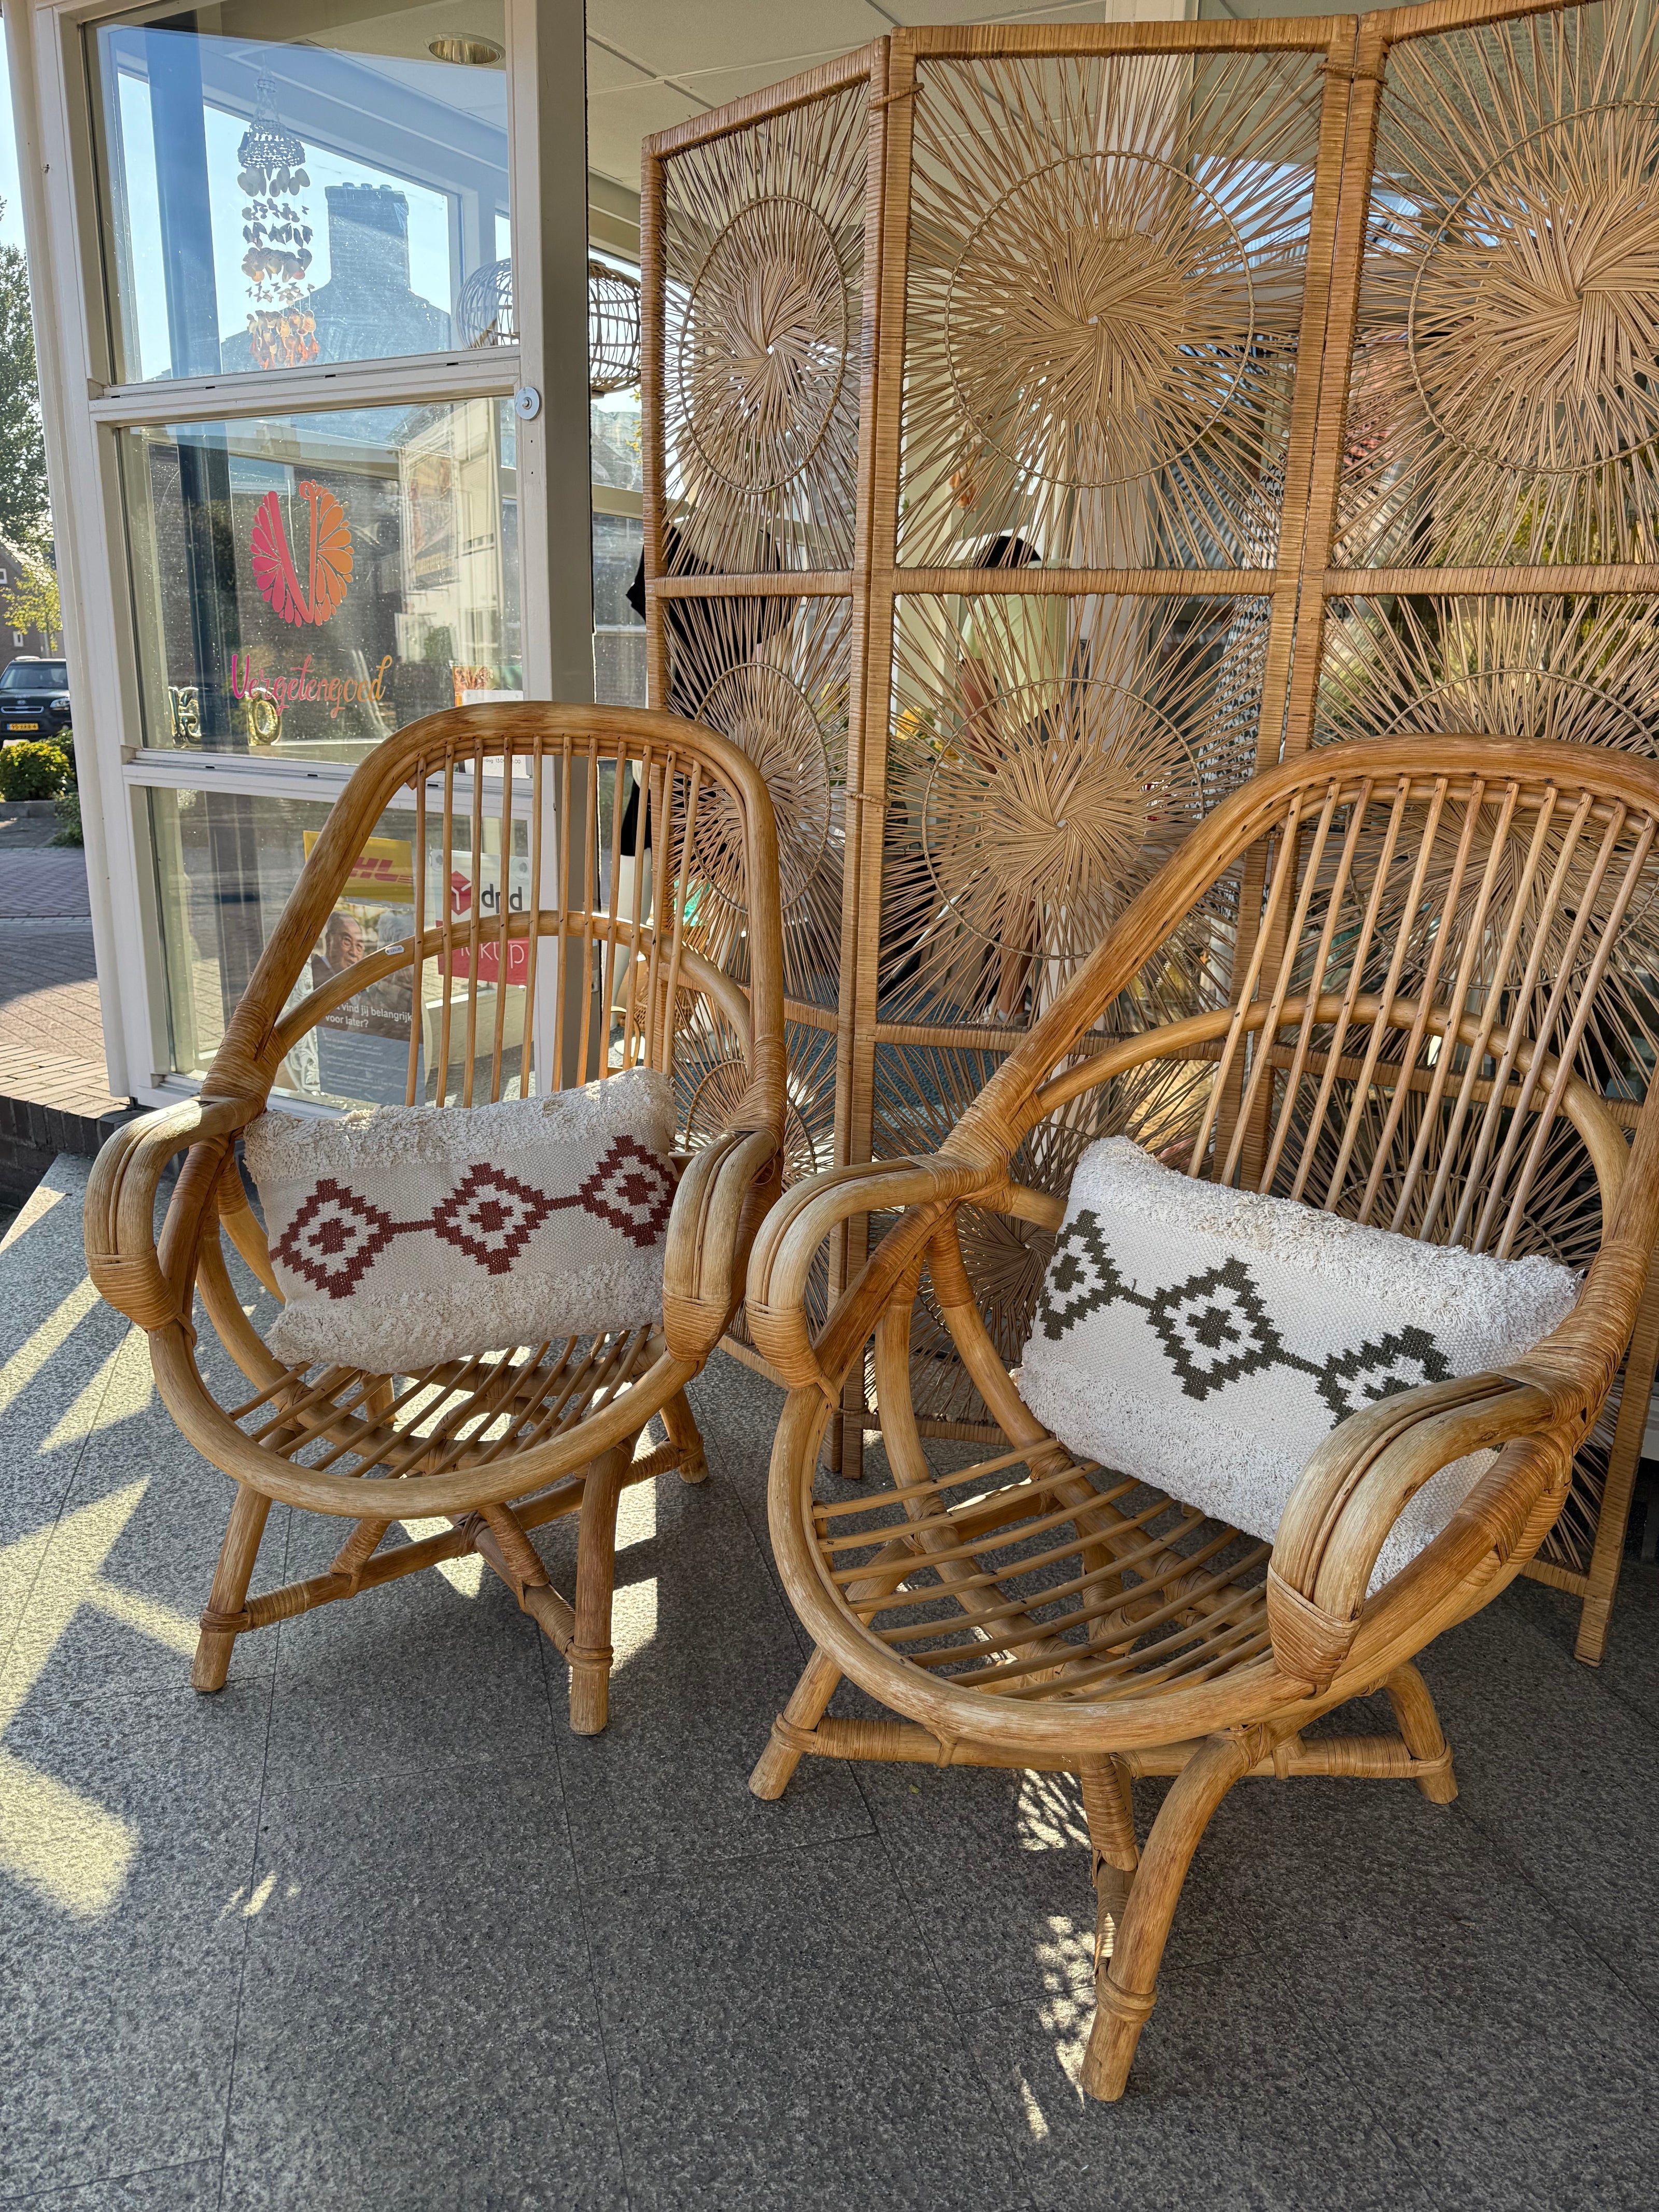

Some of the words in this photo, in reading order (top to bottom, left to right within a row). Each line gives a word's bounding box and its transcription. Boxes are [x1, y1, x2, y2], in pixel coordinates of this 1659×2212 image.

[231, 654, 392, 718] Vergetengoed
[349, 857, 399, 882] HL
[342, 1003, 359, 1013] vind
[325, 1015, 344, 1023] voor
[345, 1016, 369, 1027] later?
